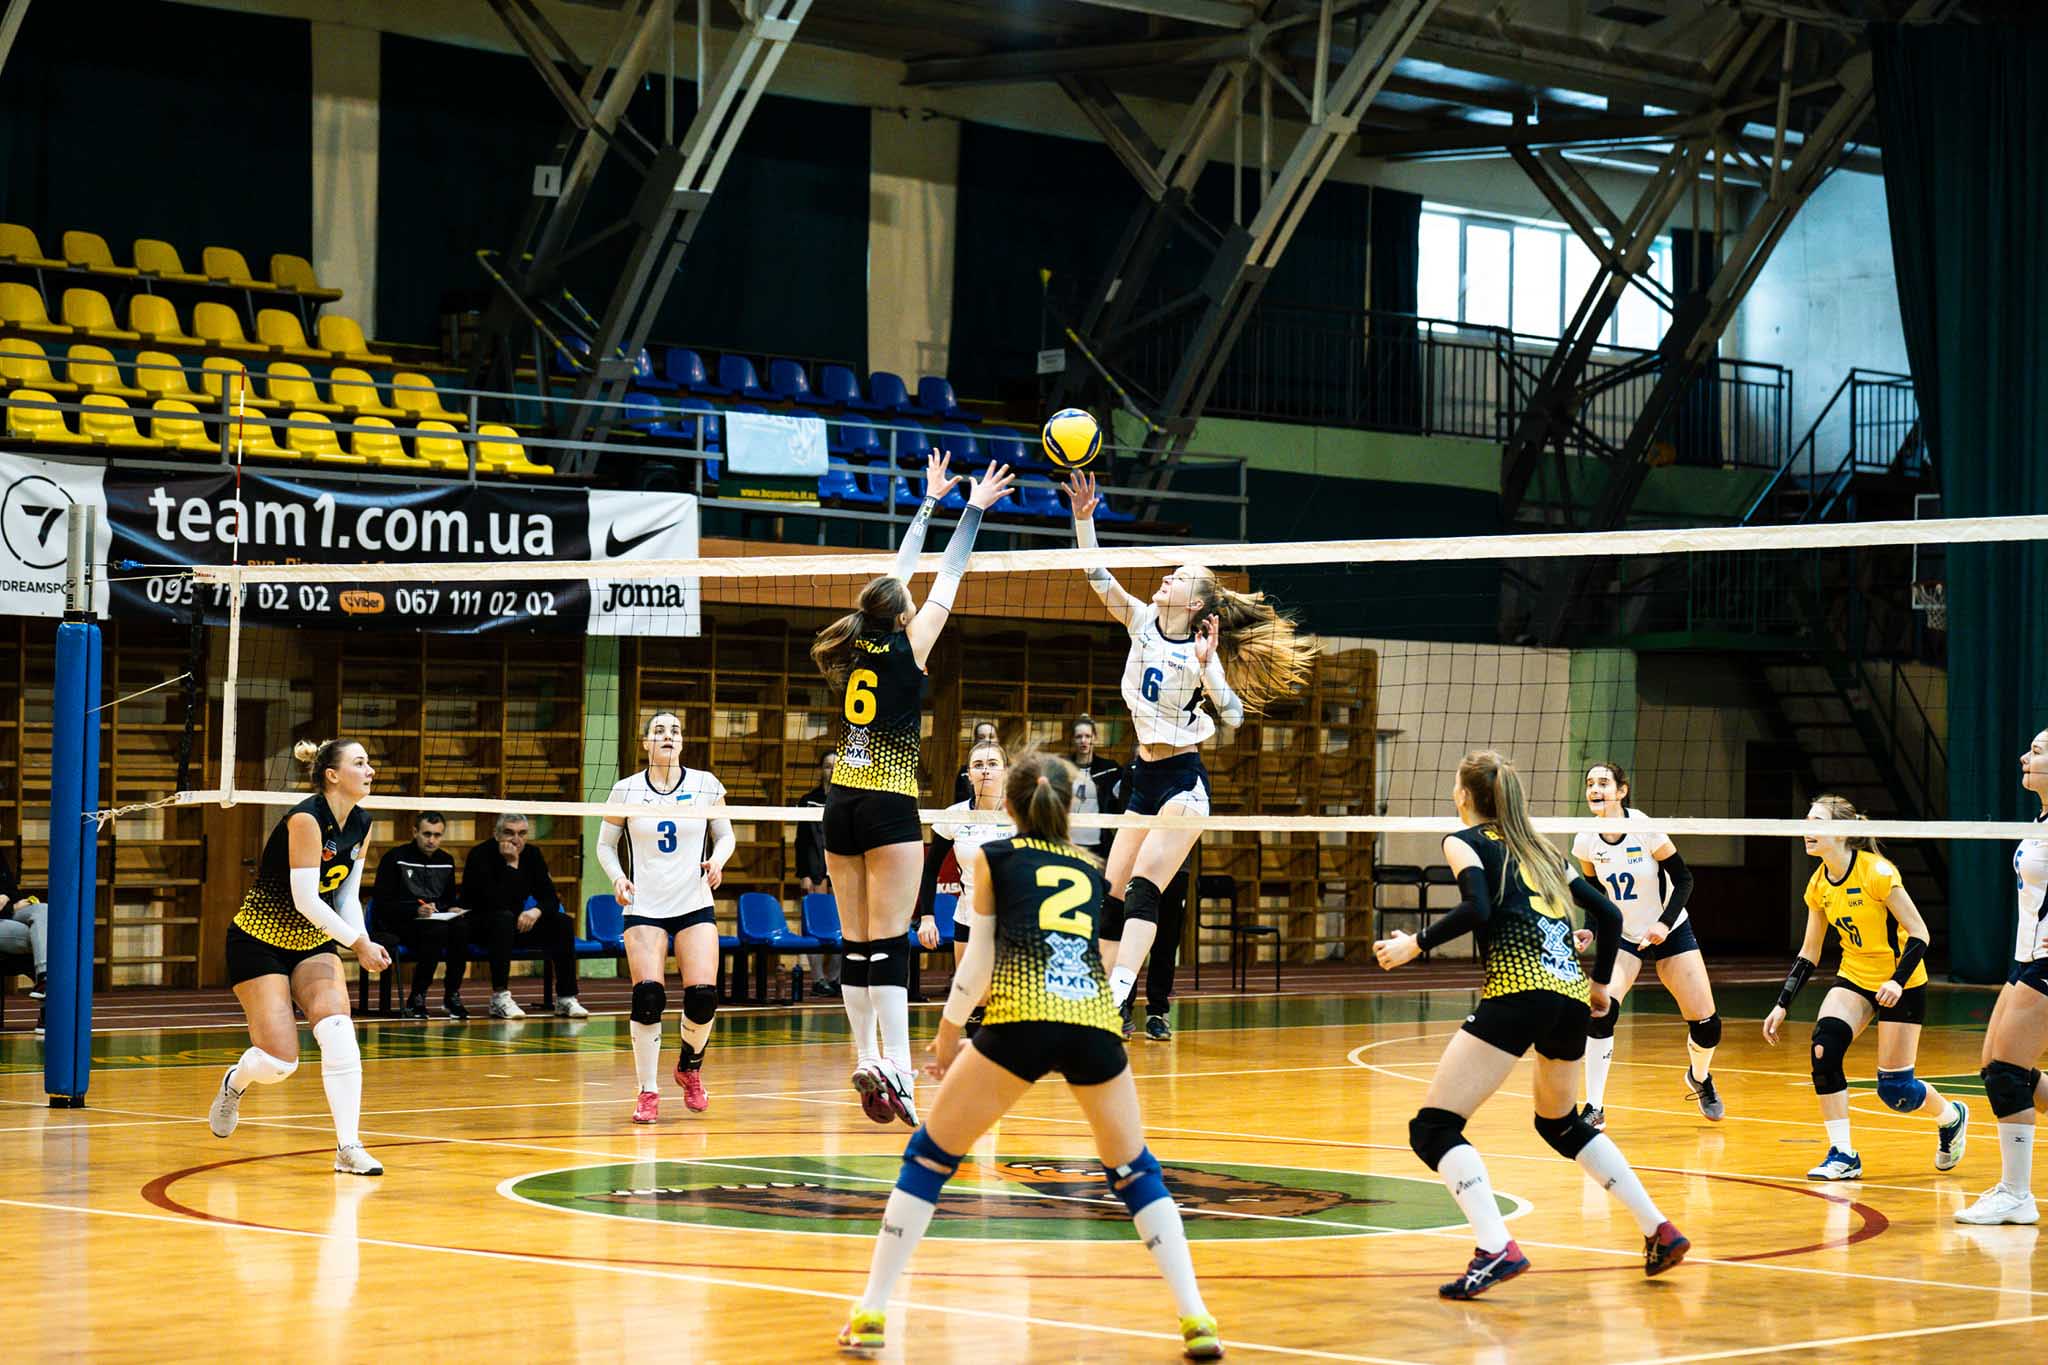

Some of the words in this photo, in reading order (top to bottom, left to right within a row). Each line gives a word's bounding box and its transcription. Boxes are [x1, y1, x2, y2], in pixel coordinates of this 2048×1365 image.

[148, 486, 554, 556] team1.com.ua
[258, 584, 289, 610] 02
[299, 586, 331, 612] 02
[353, 597, 379, 608] Viber
[395, 589, 440, 614] 067
[449, 590, 482, 615] 111
[489, 591, 517, 616] 02
[525, 592, 558, 616] 02
[844, 668, 878, 725] 6
[1141, 666, 1164, 702] 6
[657, 820, 678, 853] 3
[1036, 865, 1093, 940] 2
[1606, 872, 1638, 901] 12
[1836, 916, 1863, 948] 15
